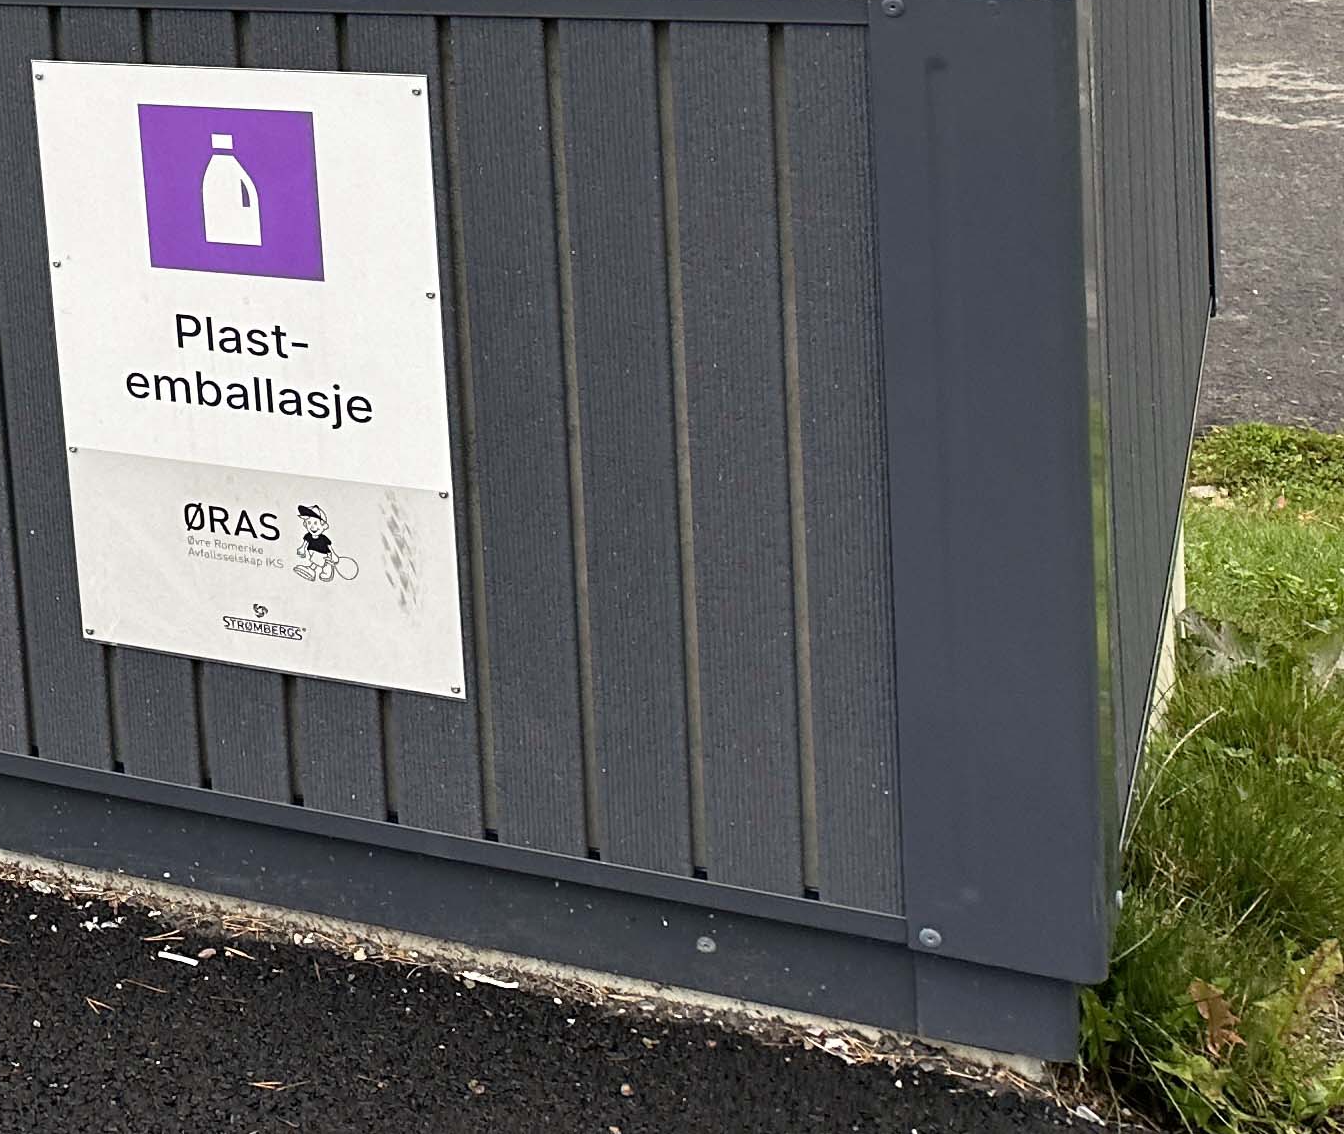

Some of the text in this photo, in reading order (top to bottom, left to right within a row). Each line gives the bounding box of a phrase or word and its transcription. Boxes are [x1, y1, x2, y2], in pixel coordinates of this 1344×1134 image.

[175, 313, 309, 359] Plast-
[126, 371, 373, 429] emballasje
[184, 502, 280, 541] ØRAS
[187, 535, 264, 555] Øvre Romerike
[188, 547, 284, 569] Avfallsselskap IKS
[223, 615, 303, 641] STRØMBERGS
